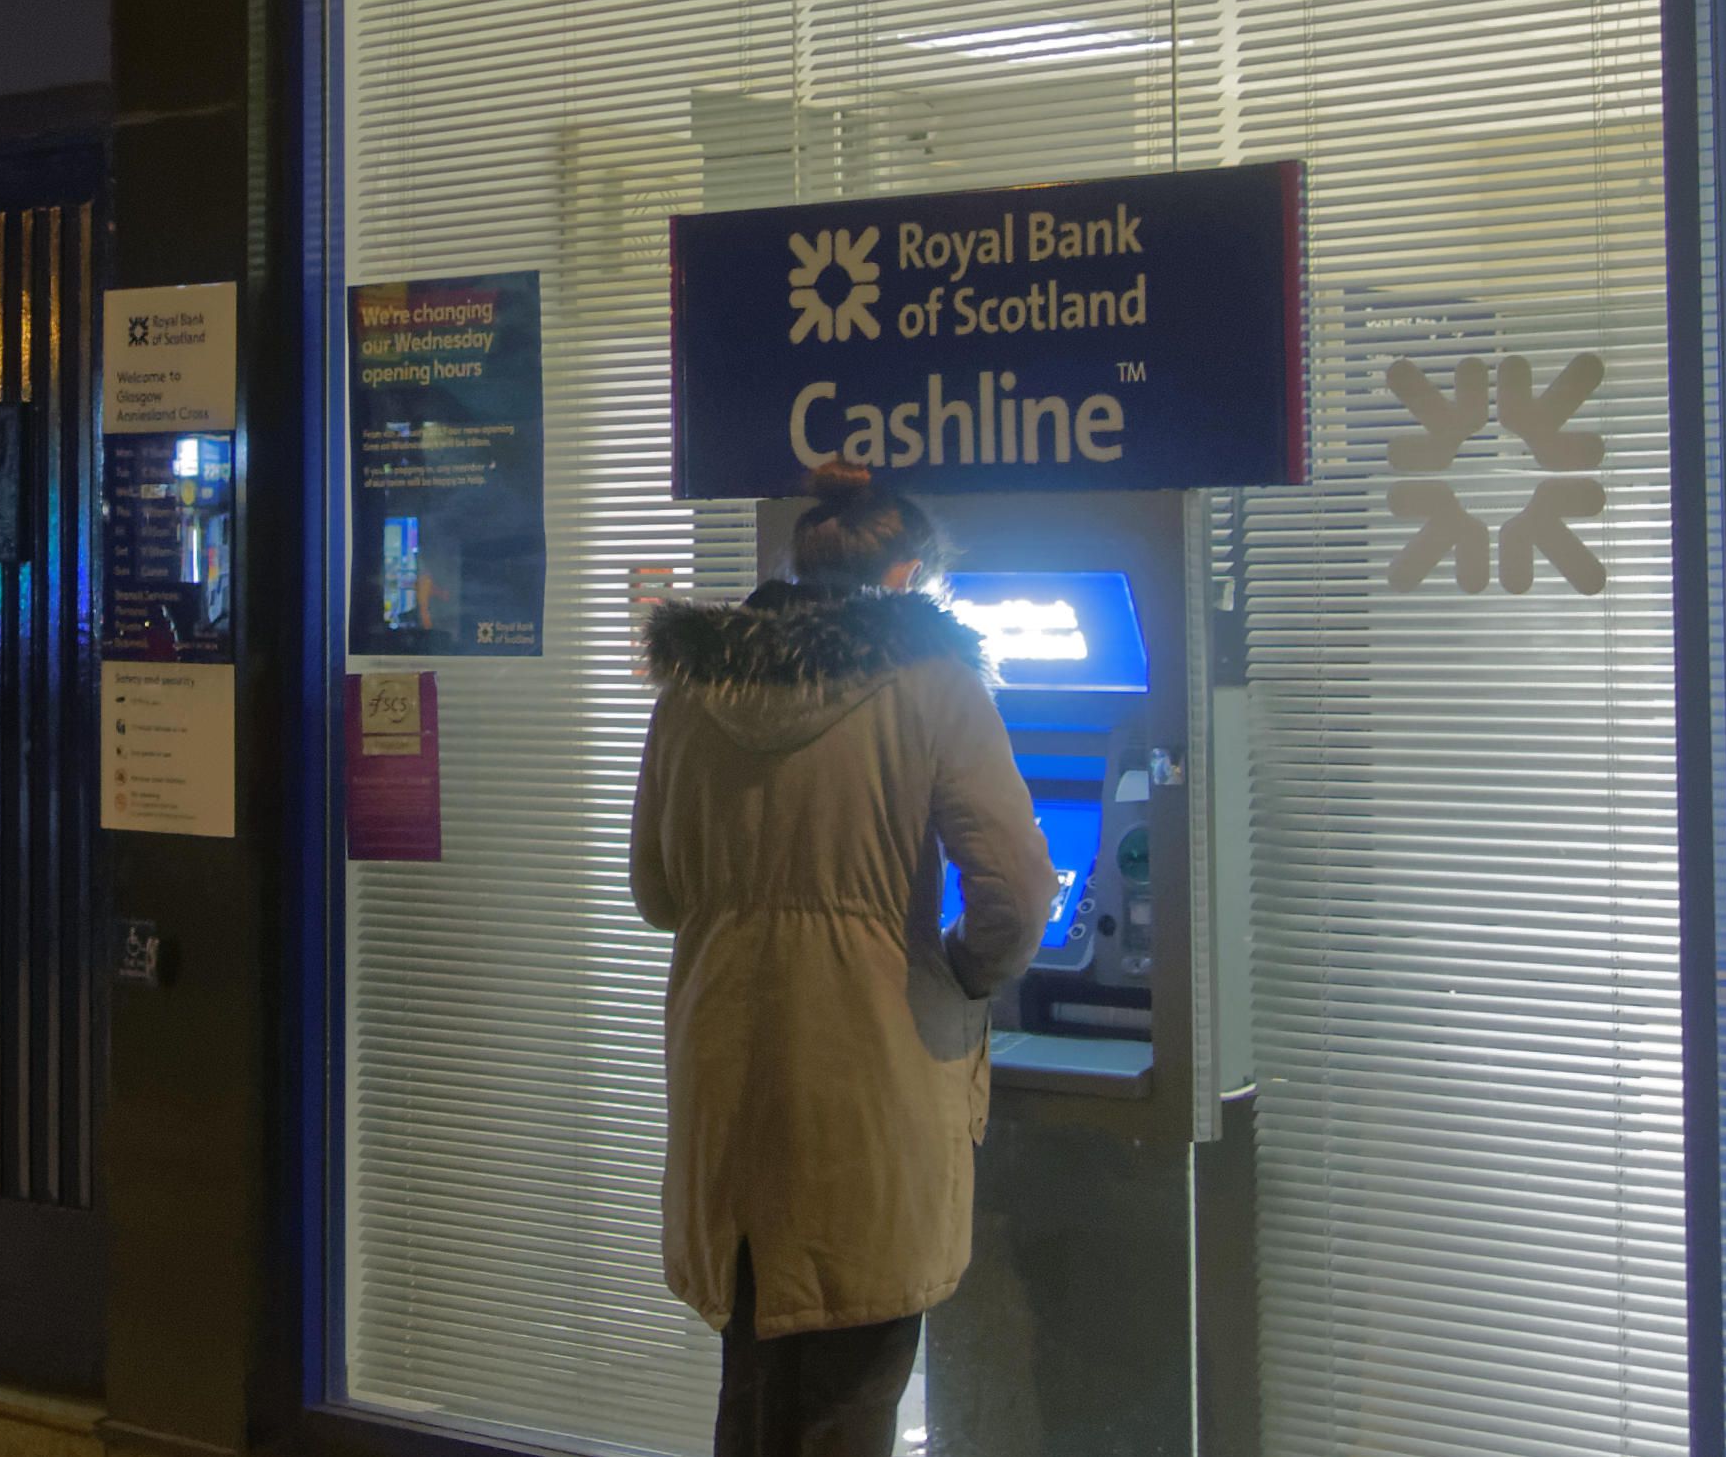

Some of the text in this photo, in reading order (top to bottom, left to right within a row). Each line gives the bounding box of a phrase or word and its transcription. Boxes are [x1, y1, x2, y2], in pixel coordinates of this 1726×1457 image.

[898, 202, 1144, 282] Royal Bank
[361, 298, 494, 327] We're changing
[898, 272, 1147, 339] of Scotland
[153, 313, 205, 328] Royal Bank
[152, 331, 206, 346] of Scotland
[362, 328, 494, 355] our Wednesday
[116, 370, 182, 384] Welcome to
[362, 358, 483, 388] opening hours
[116, 390, 163, 407] Glasgow
[116, 406, 210, 422] Anniesland Cross
[789, 370, 1125, 469] Cashline
